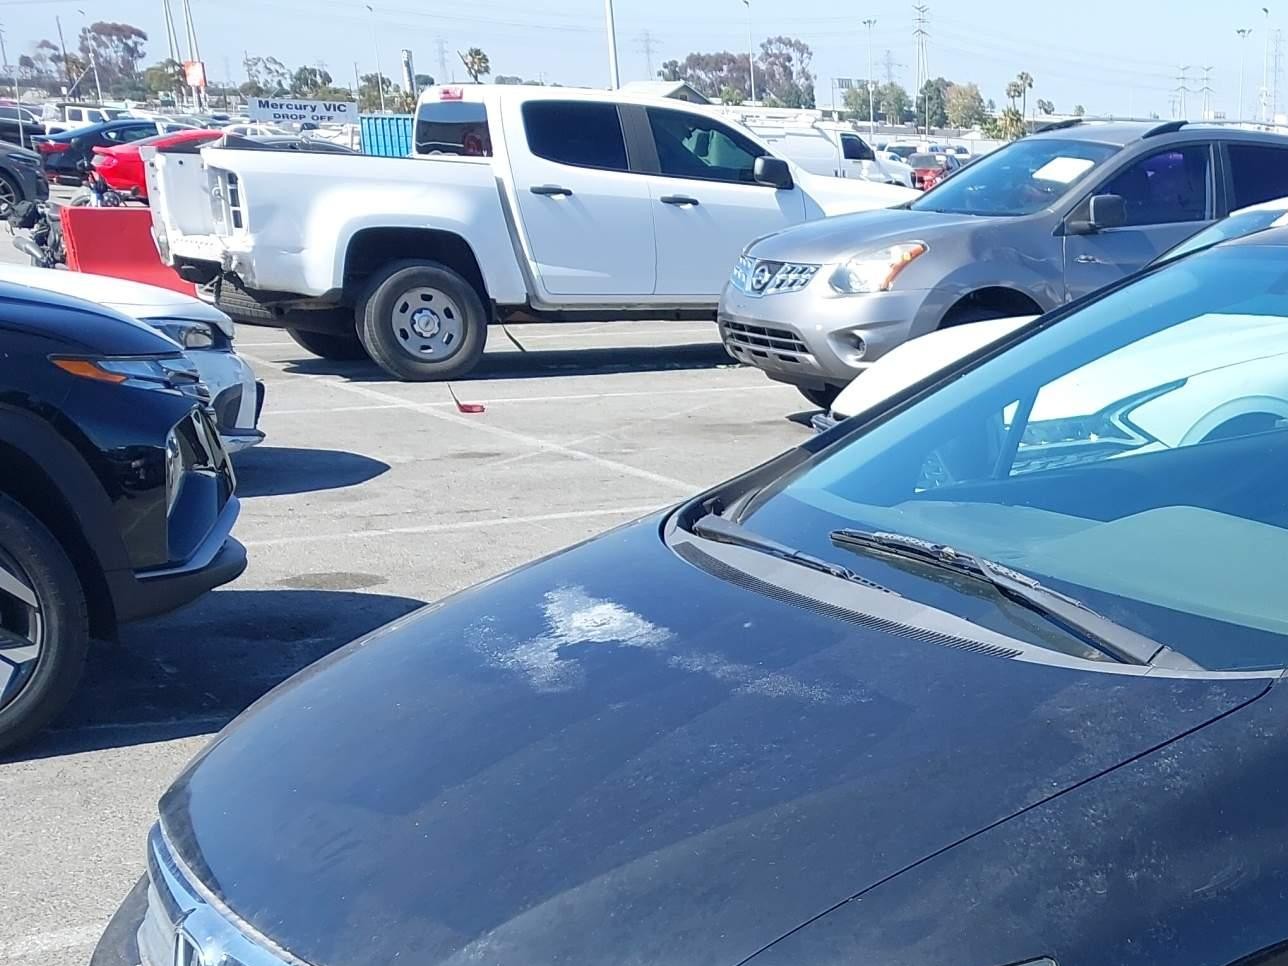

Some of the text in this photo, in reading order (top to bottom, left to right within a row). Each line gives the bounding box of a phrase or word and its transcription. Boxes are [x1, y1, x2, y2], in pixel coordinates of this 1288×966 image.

[258, 100, 347, 112] Mercury VIC
[273, 113, 335, 122] DROP OFF
